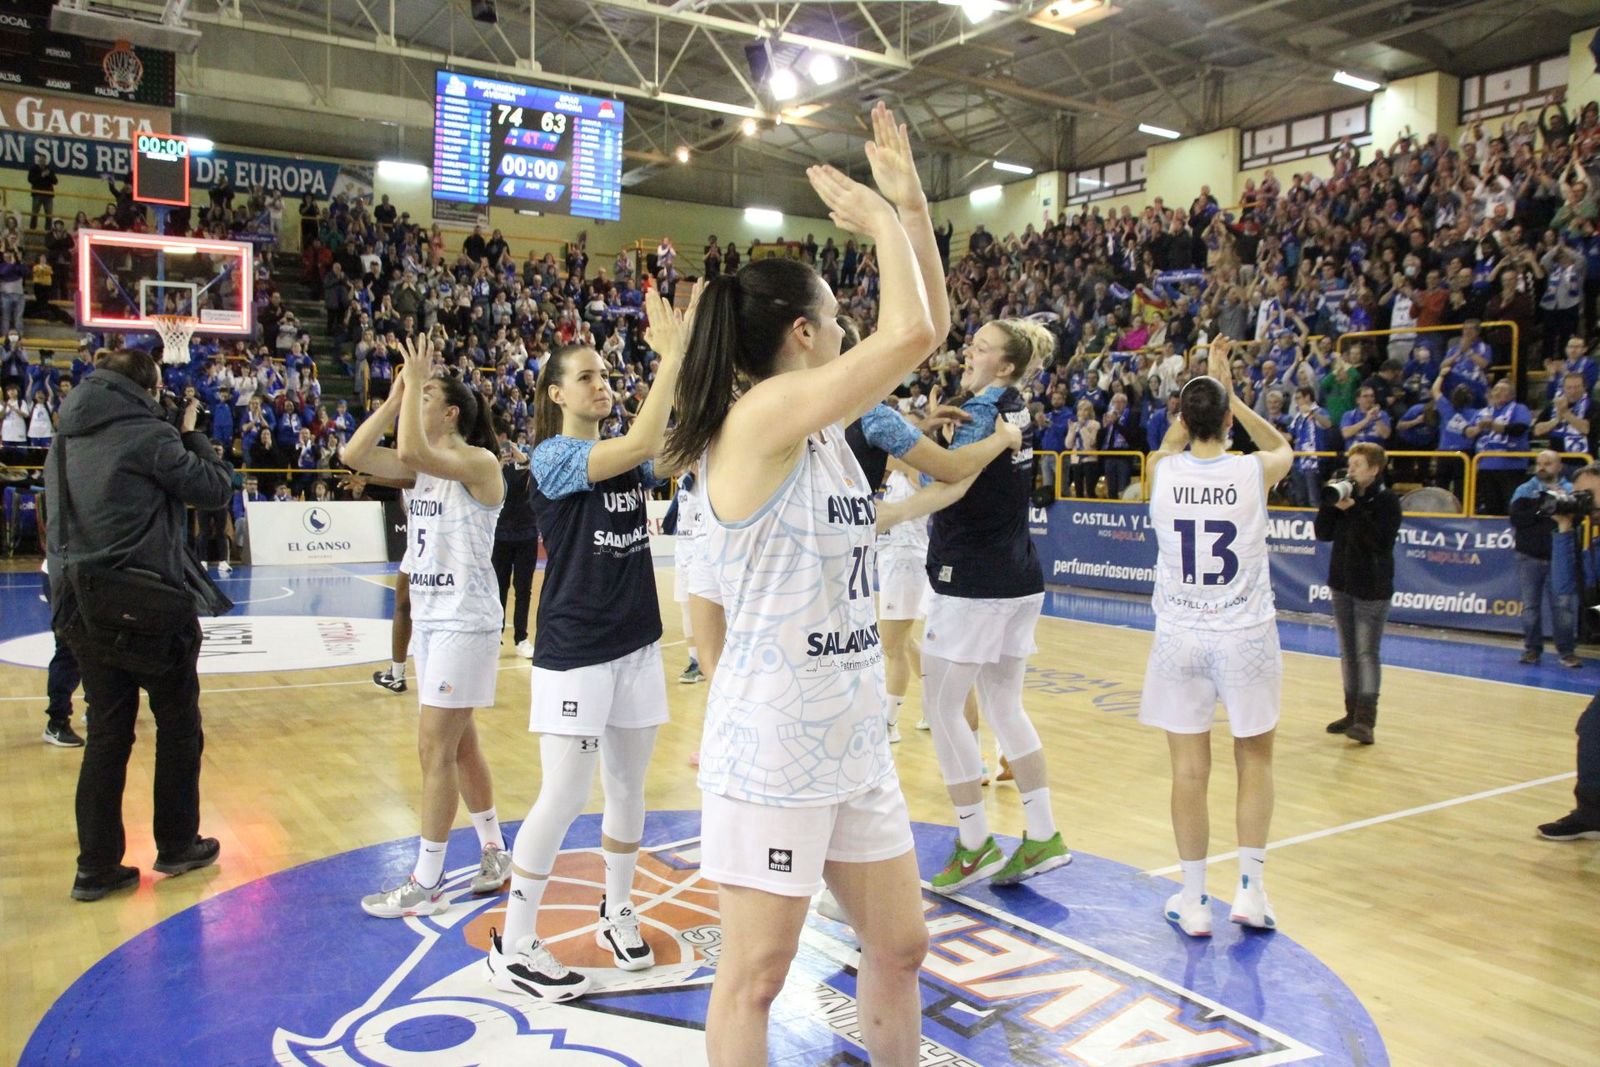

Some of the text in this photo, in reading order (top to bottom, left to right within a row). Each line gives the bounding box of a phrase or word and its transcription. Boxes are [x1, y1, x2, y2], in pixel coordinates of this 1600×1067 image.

[15, 96, 153, 141] GACETA
[498, 104, 566, 134] 74 63
[138, 135, 188, 158] 00:00
[33, 138, 89, 170] SUS
[95, 145, 134, 176] RE
[196, 157, 229, 184] DE
[235, 161, 328, 195] EUROPA
[502, 154, 559, 181] 00:00
[502, 179, 516, 196] 4
[1173, 483, 1237, 505] VILARÓ
[1072, 511, 1153, 530] CASTILLA Y L
[288, 541, 351, 552] EL GANSO
[417, 528, 426, 558] 5
[1174, 519, 1239, 585] 13
[1455, 532, 1469, 551] Y
